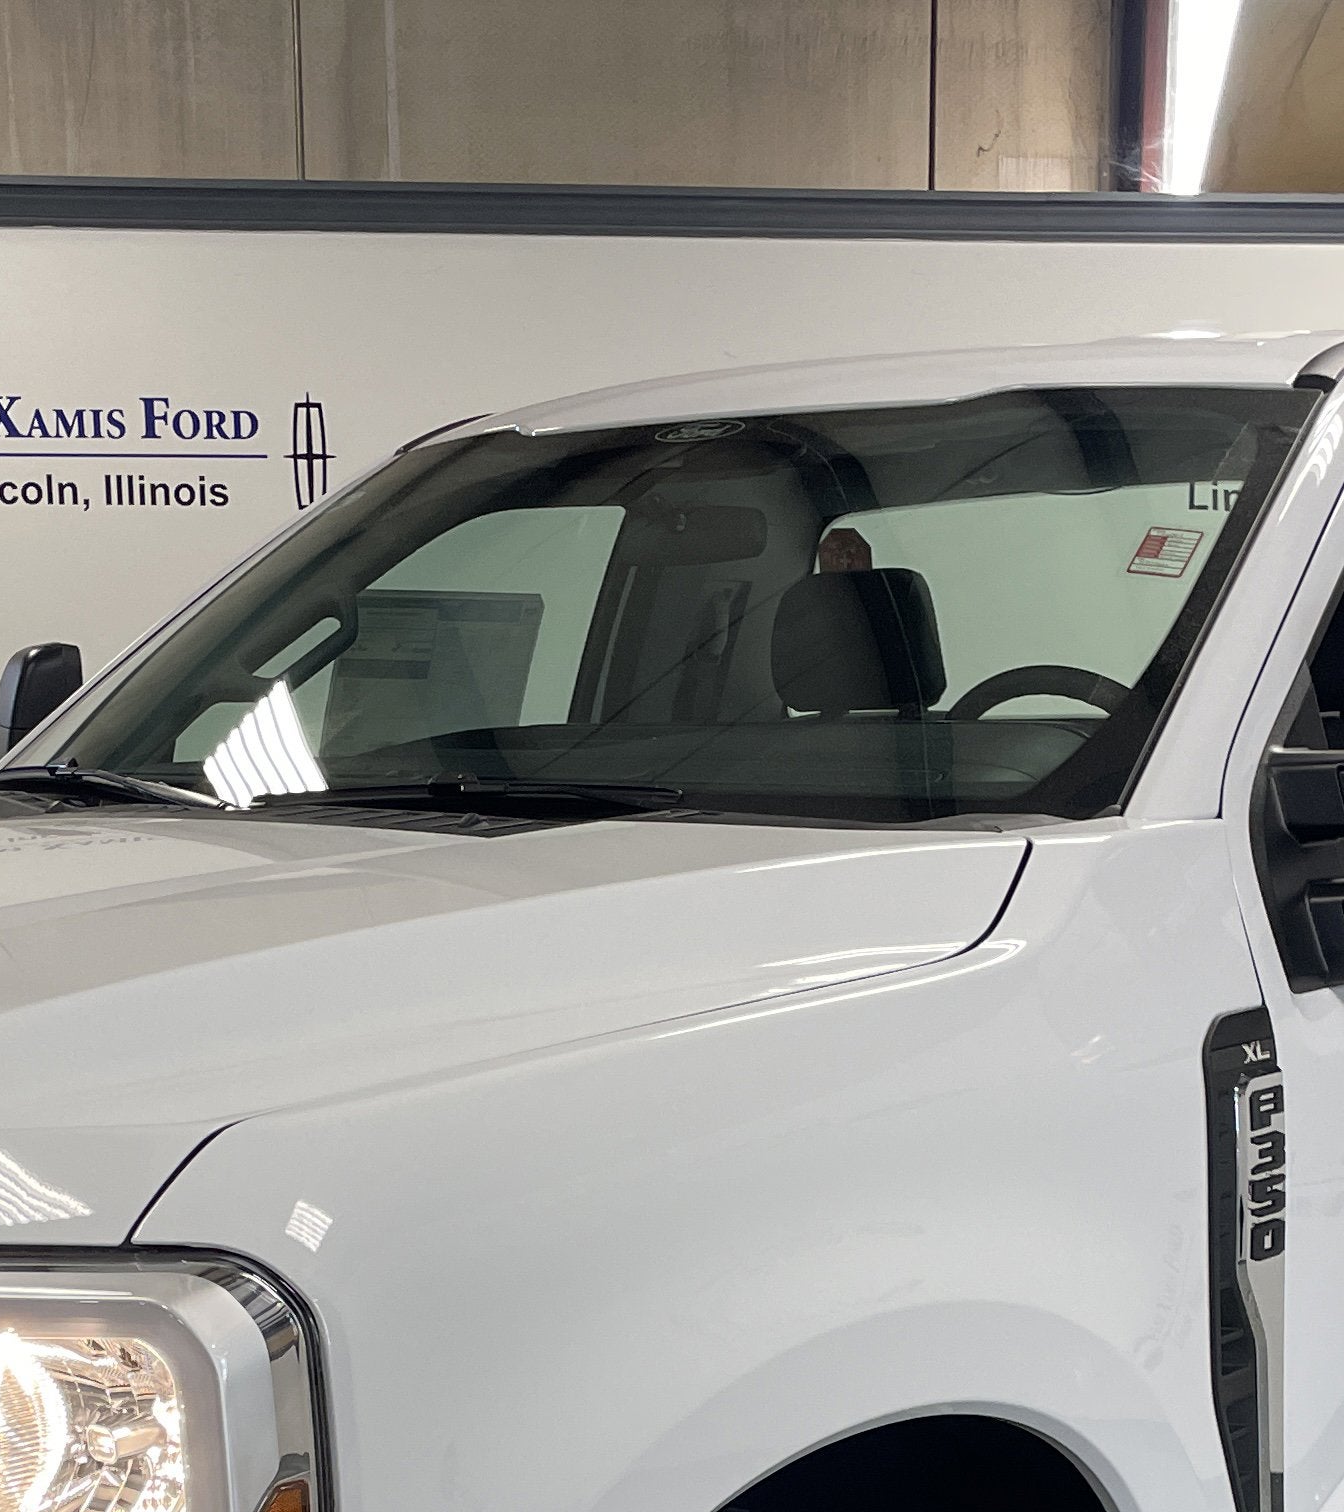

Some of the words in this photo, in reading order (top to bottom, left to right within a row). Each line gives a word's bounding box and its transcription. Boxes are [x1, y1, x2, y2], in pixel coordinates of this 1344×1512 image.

[139, 397, 259, 441] FORD
[105, 476, 230, 506] Illinois
[1241, 1041, 1271, 1064] XL
